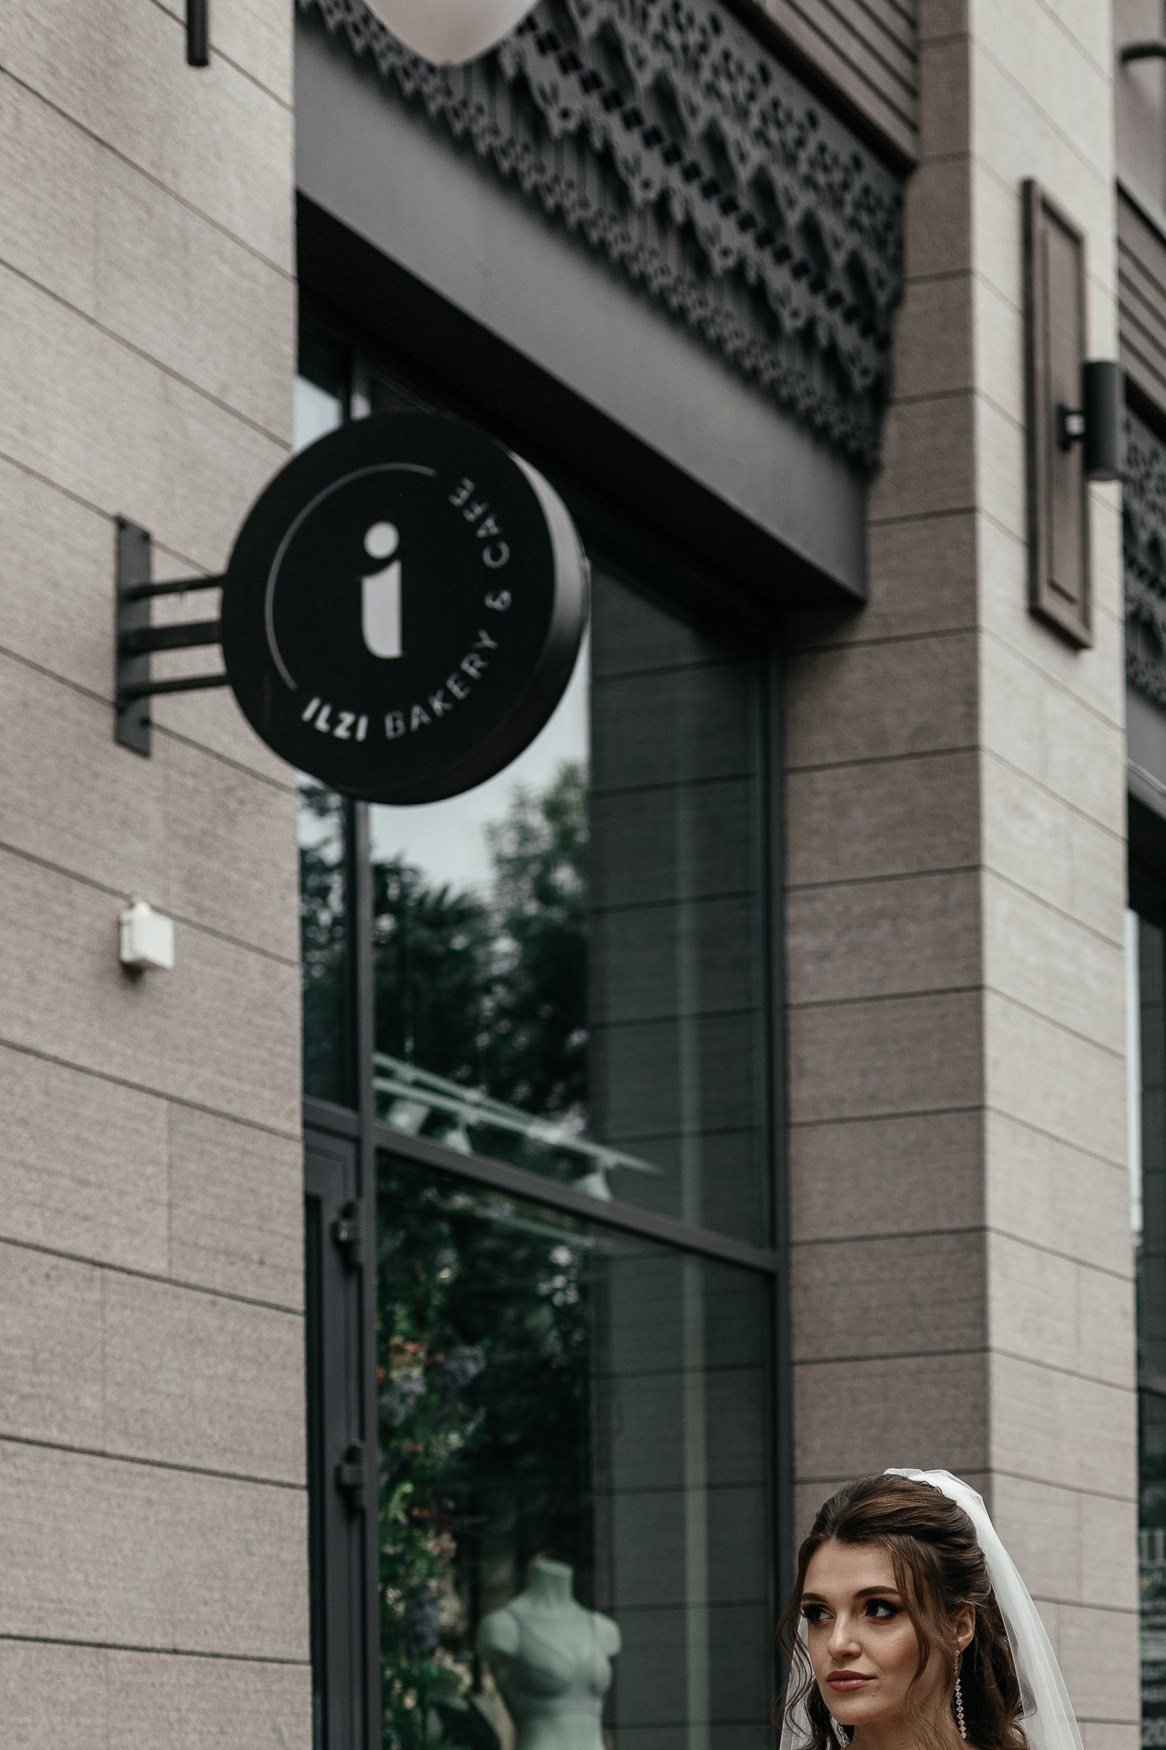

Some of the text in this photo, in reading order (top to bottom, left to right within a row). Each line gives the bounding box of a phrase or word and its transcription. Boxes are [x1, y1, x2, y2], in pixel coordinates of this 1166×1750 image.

[301, 476, 511, 742] ILZI BAKERY & CAFE
